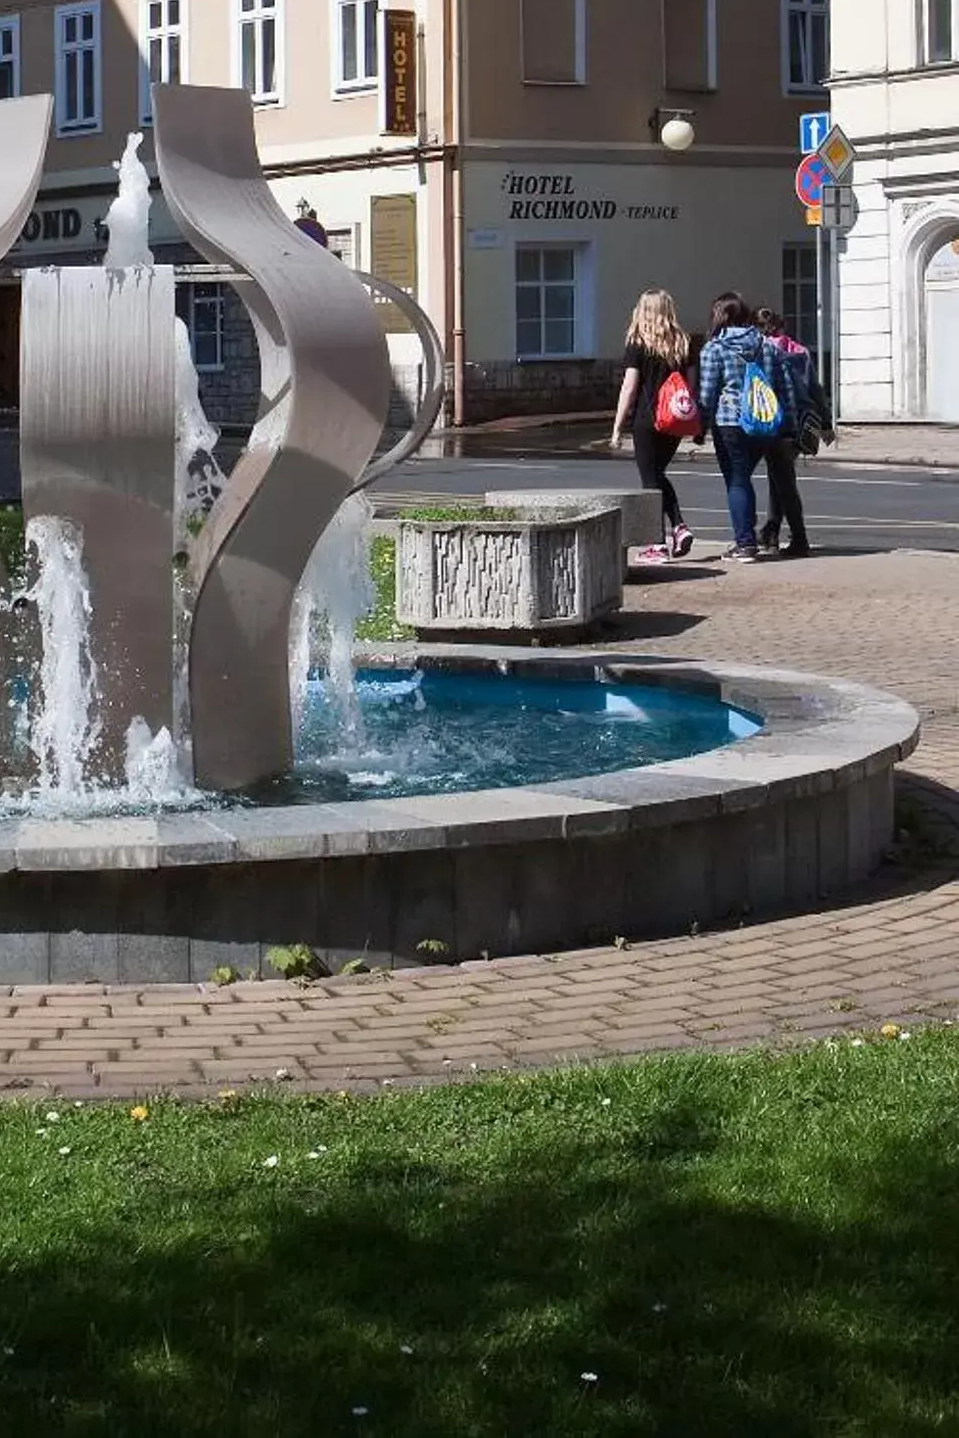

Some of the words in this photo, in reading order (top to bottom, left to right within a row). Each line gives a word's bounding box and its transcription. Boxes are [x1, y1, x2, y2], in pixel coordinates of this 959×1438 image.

[393, 31, 407, 122] HOTEL
[508, 175, 575, 195] HOTEL
[509, 200, 617, 220] RICHMOND
